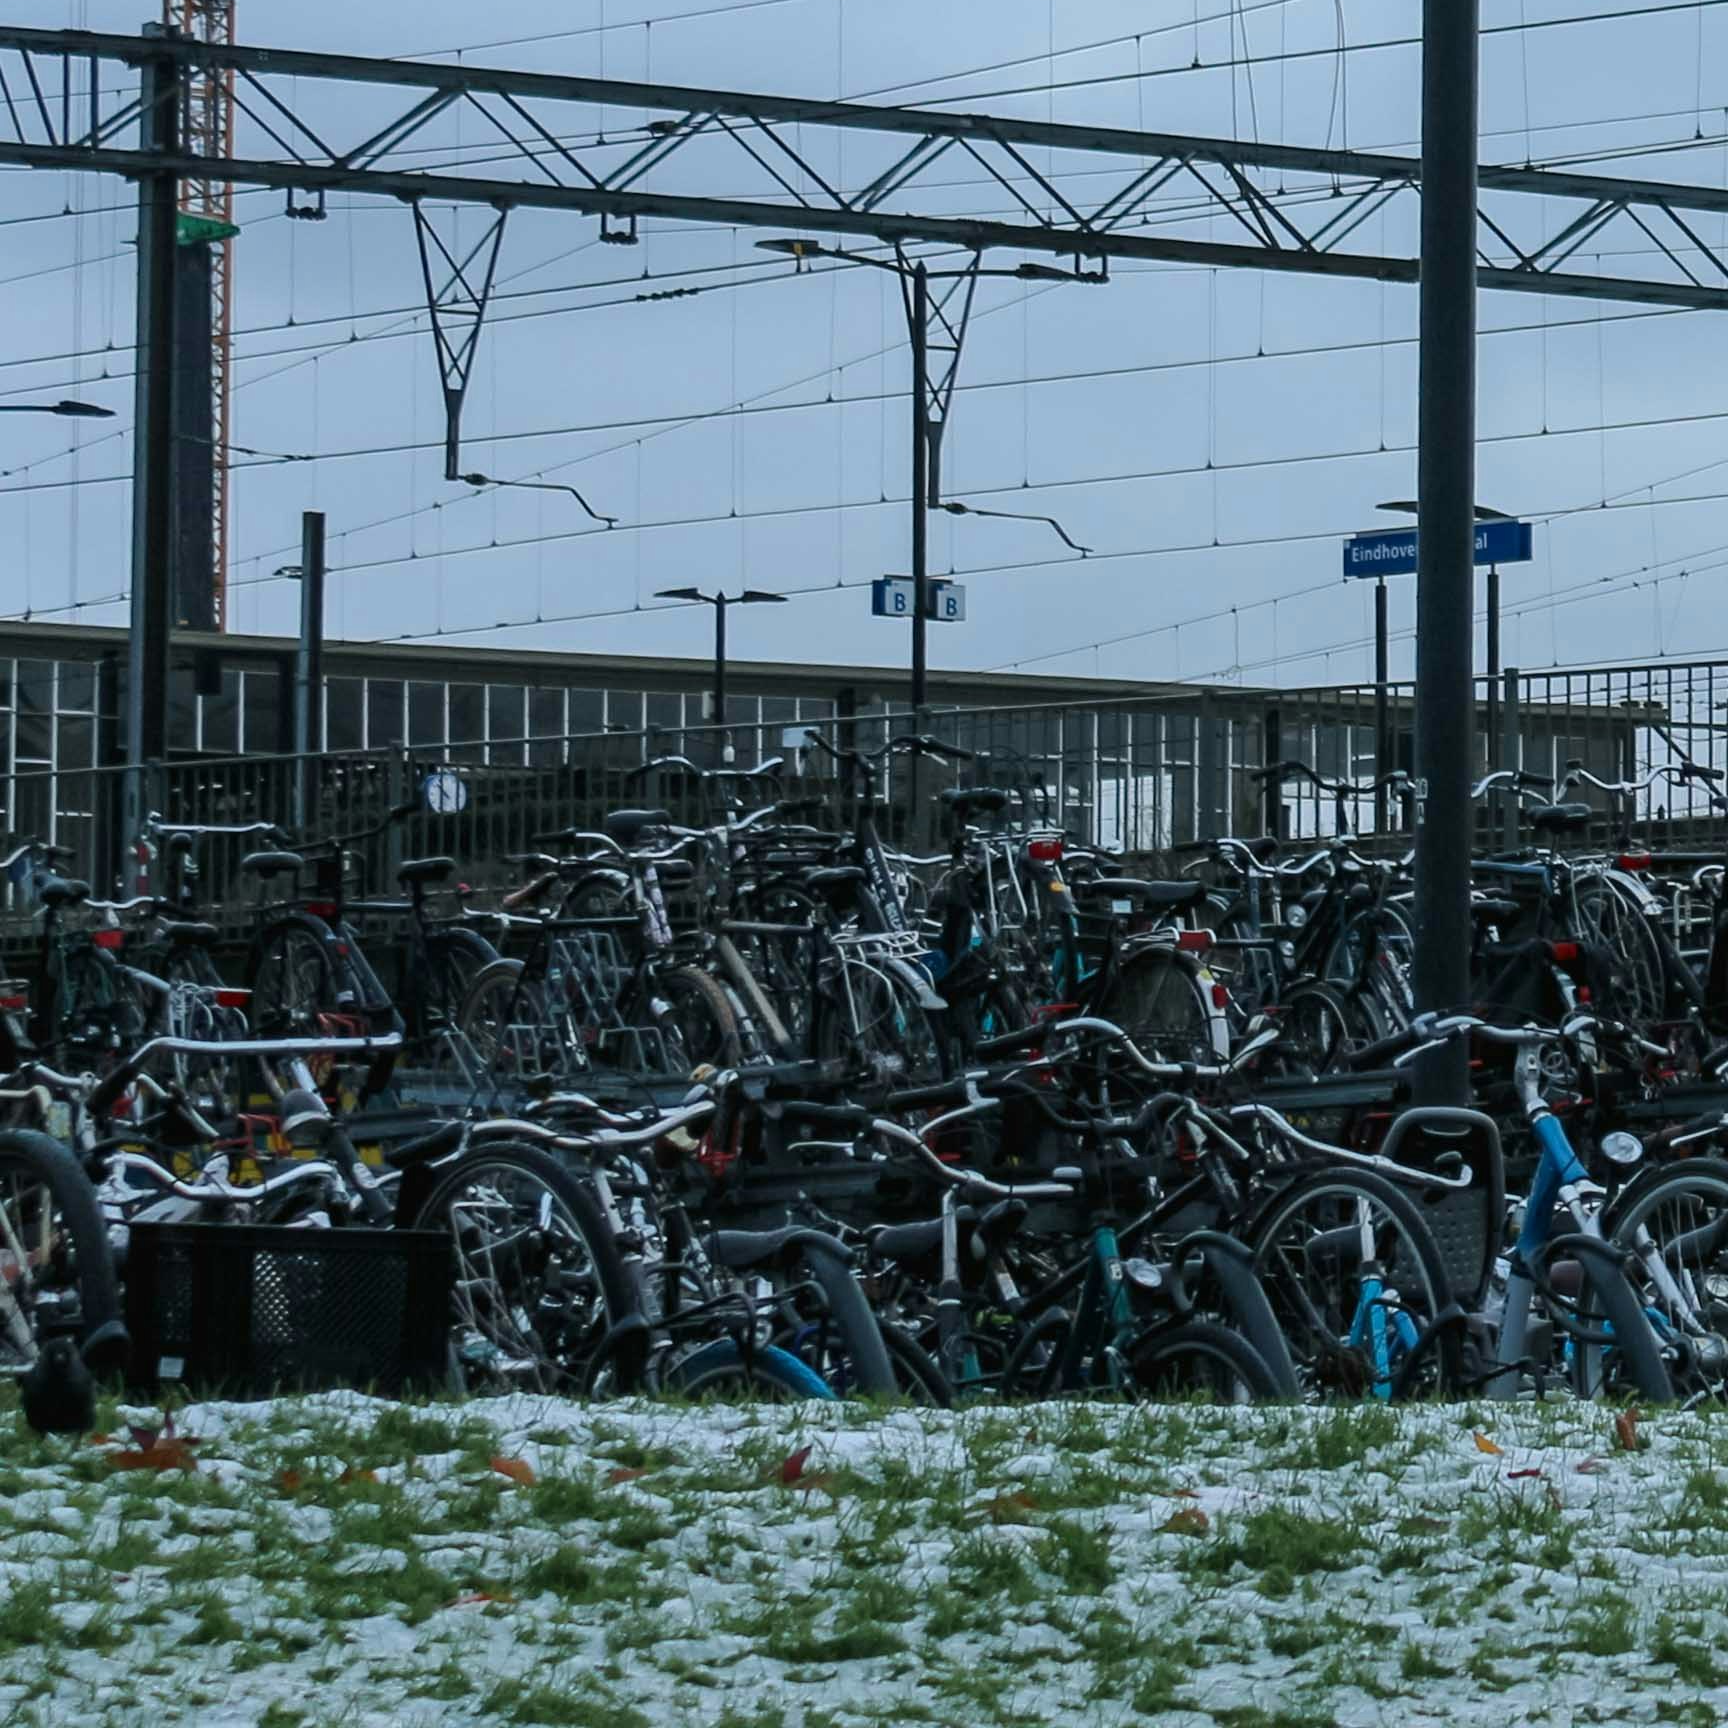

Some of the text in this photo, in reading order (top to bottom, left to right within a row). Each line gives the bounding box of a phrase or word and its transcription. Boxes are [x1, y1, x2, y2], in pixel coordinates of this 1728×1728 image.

[1351, 542, 1417, 563] Eindhove
[895, 593, 906, 612] B
[946, 597, 957, 617] B
